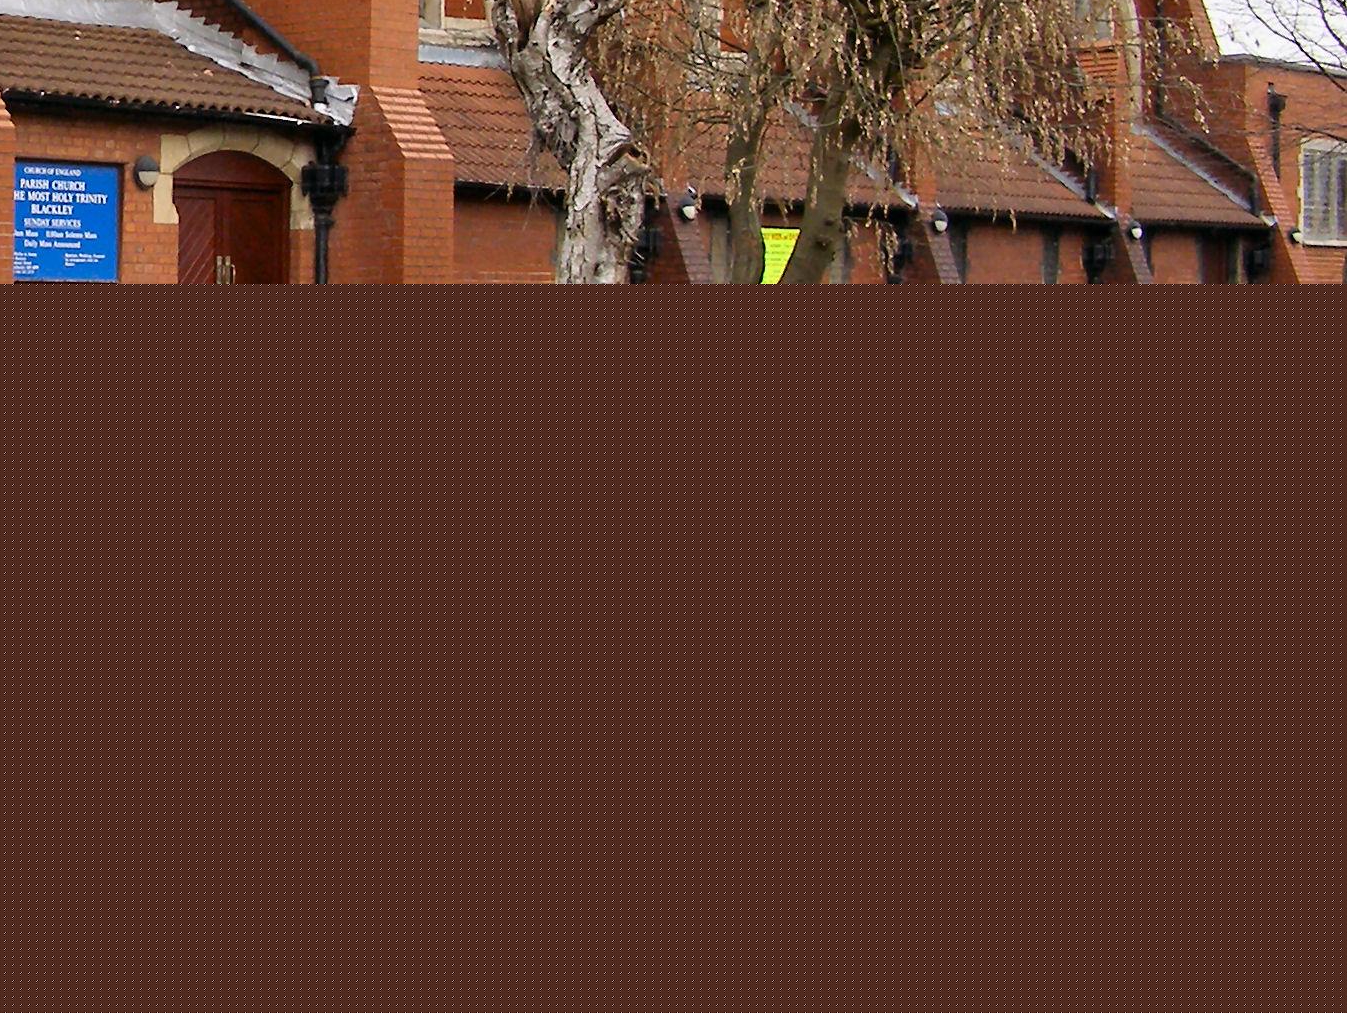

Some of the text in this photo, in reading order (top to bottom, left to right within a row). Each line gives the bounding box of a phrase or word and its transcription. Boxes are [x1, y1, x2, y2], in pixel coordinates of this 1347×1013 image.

[24, 167, 82, 177] CHURCH OF ENGLAND
[20, 178, 86, 191] PARISH CHURCH
[13, 190, 108, 204] HE MOST HOLY TRINITY
[31, 204, 74, 215] BLACKLEY
[24, 218, 82, 228] SUNDAY SERVICES
